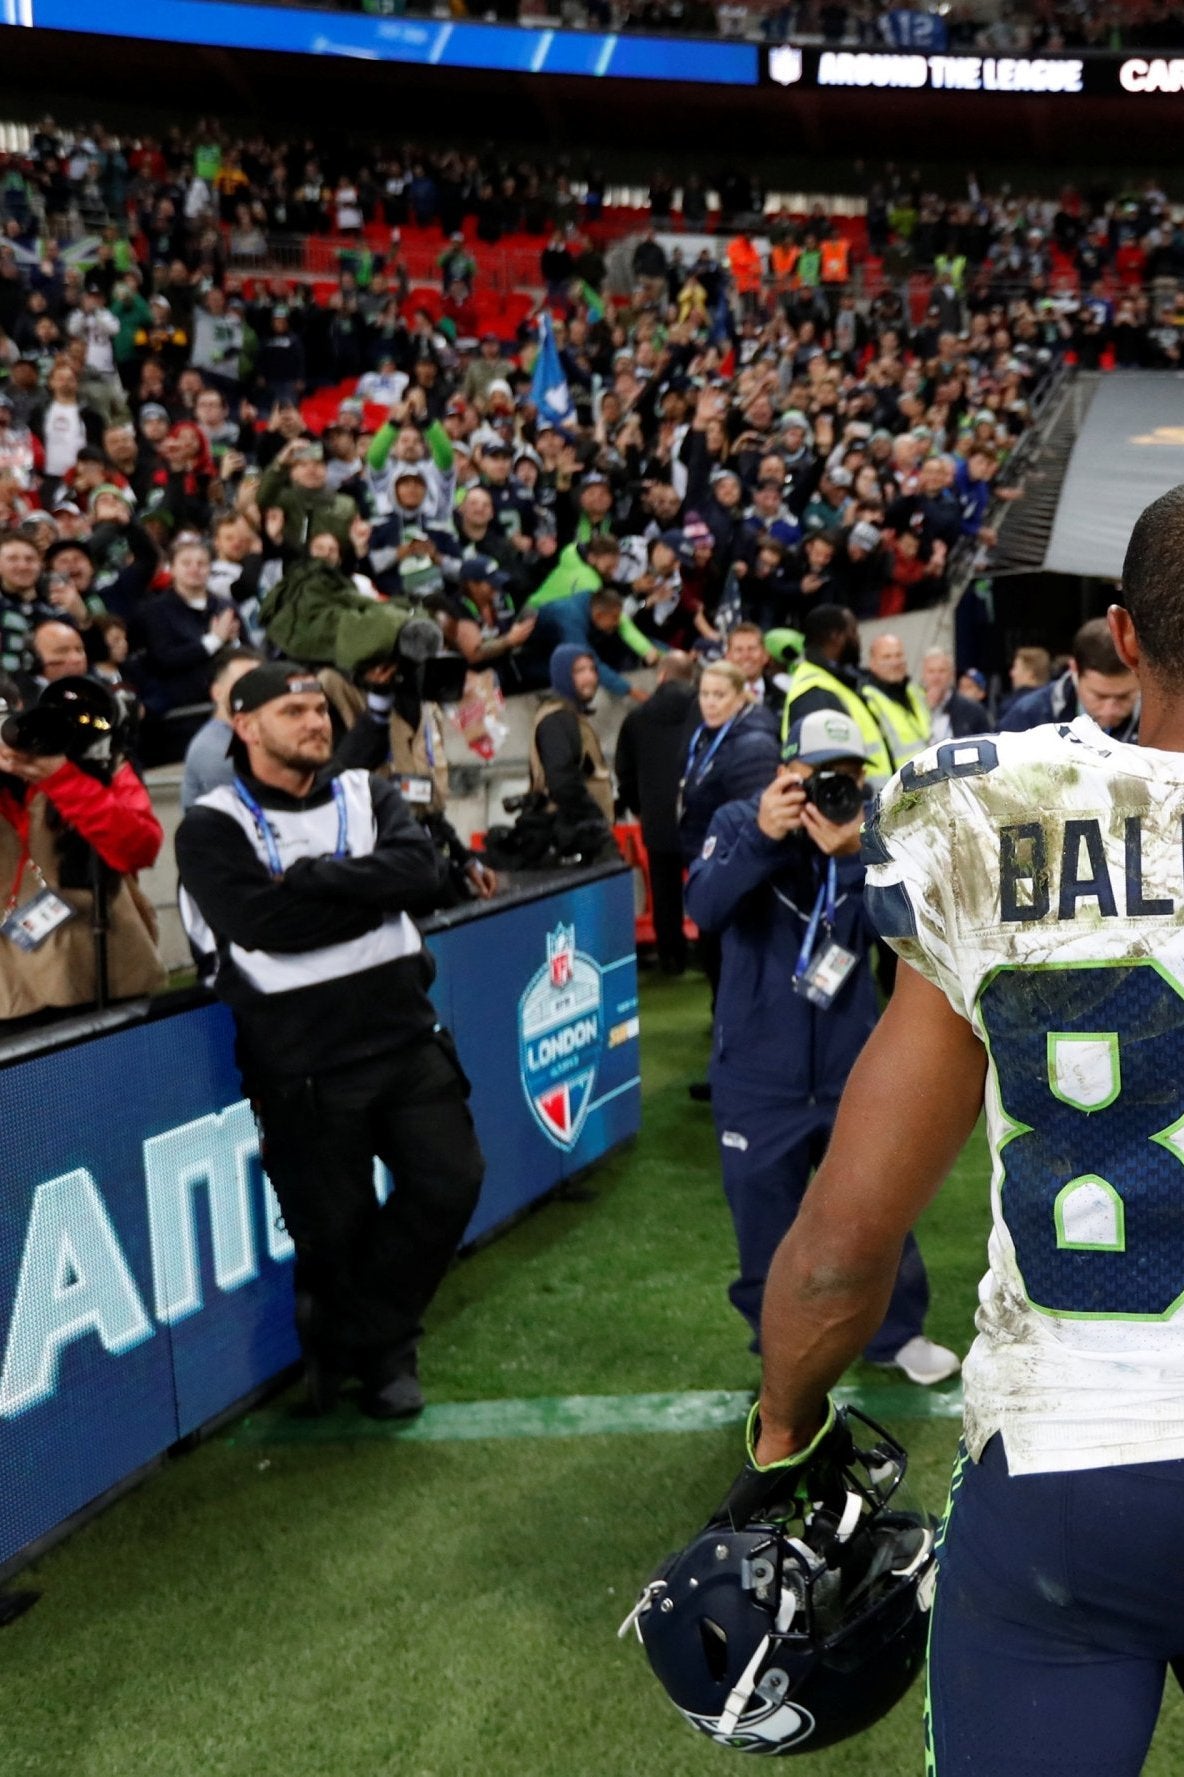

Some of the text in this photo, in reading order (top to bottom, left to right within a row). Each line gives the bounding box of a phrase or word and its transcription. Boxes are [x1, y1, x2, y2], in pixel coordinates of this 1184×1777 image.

[817, 52, 1083, 92] AROUND THE LEAGUE
[527, 1015, 598, 1074] LONDON
